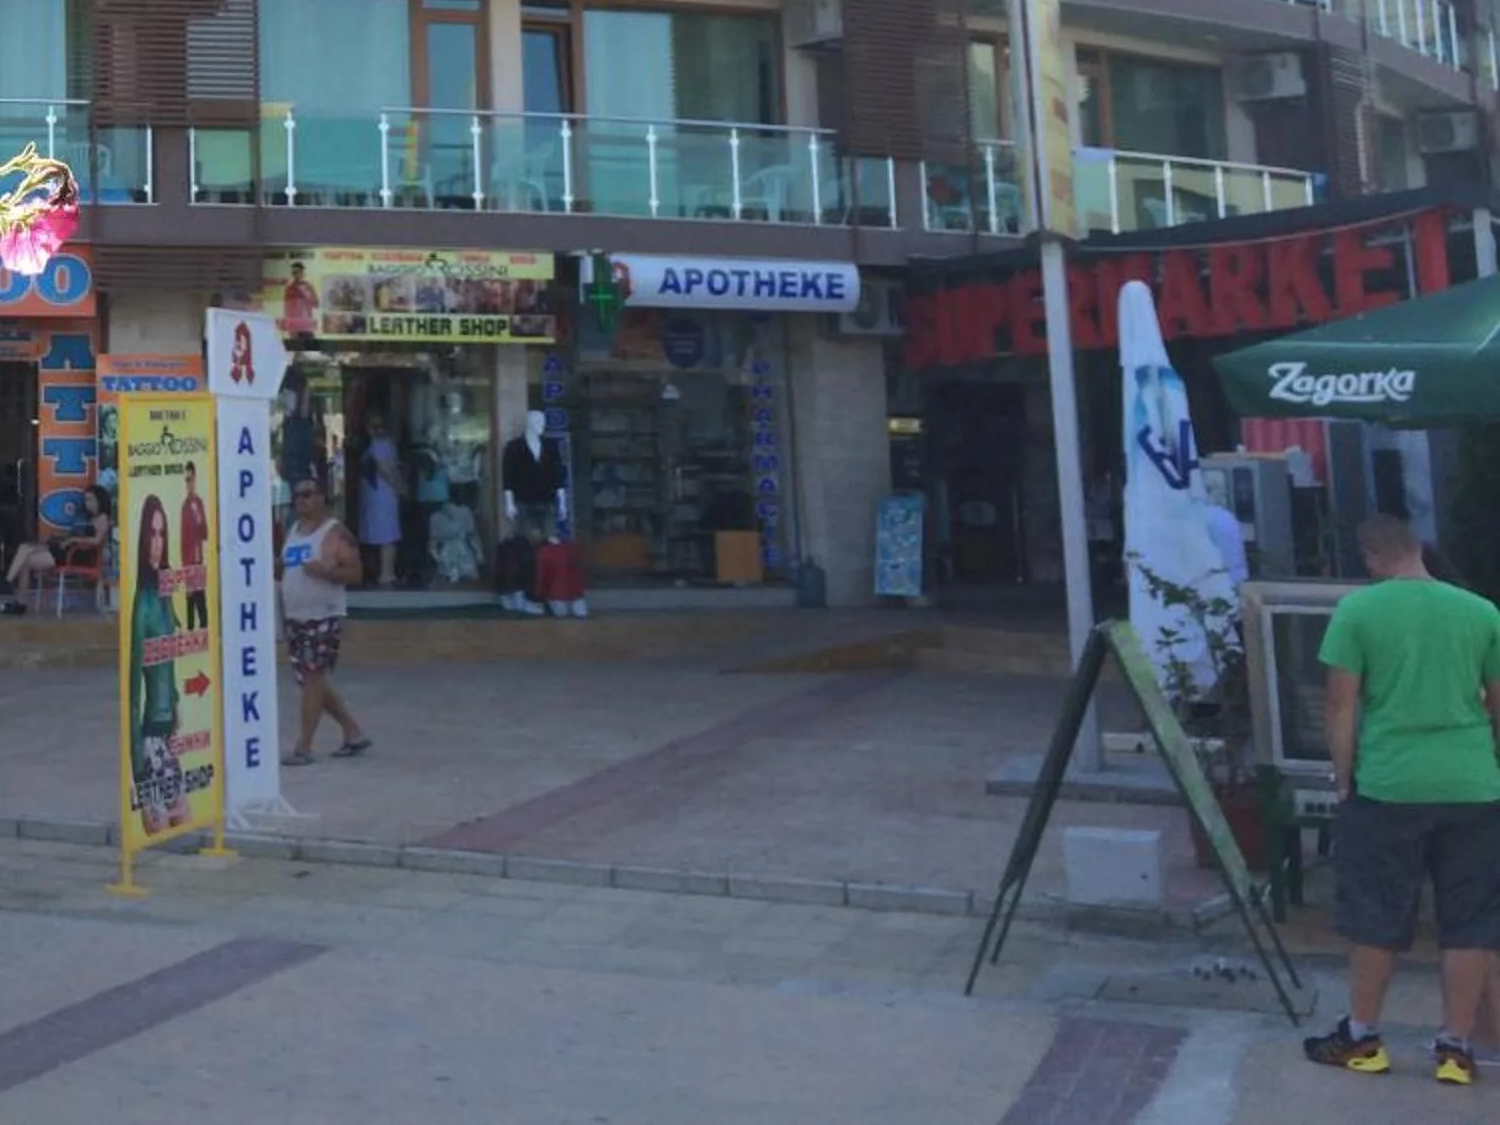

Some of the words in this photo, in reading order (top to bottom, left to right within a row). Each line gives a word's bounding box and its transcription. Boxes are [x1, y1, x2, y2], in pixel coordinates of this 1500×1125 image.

[658, 266, 846, 300] APOTHEKE
[369, 315, 450, 337] LEATHER
[458, 315, 509, 338] SHOP
[101, 376, 197, 392] TATTOO
[1268, 360, 1416, 406] Zagorka
[238, 426, 260, 768] APOTHEKE
